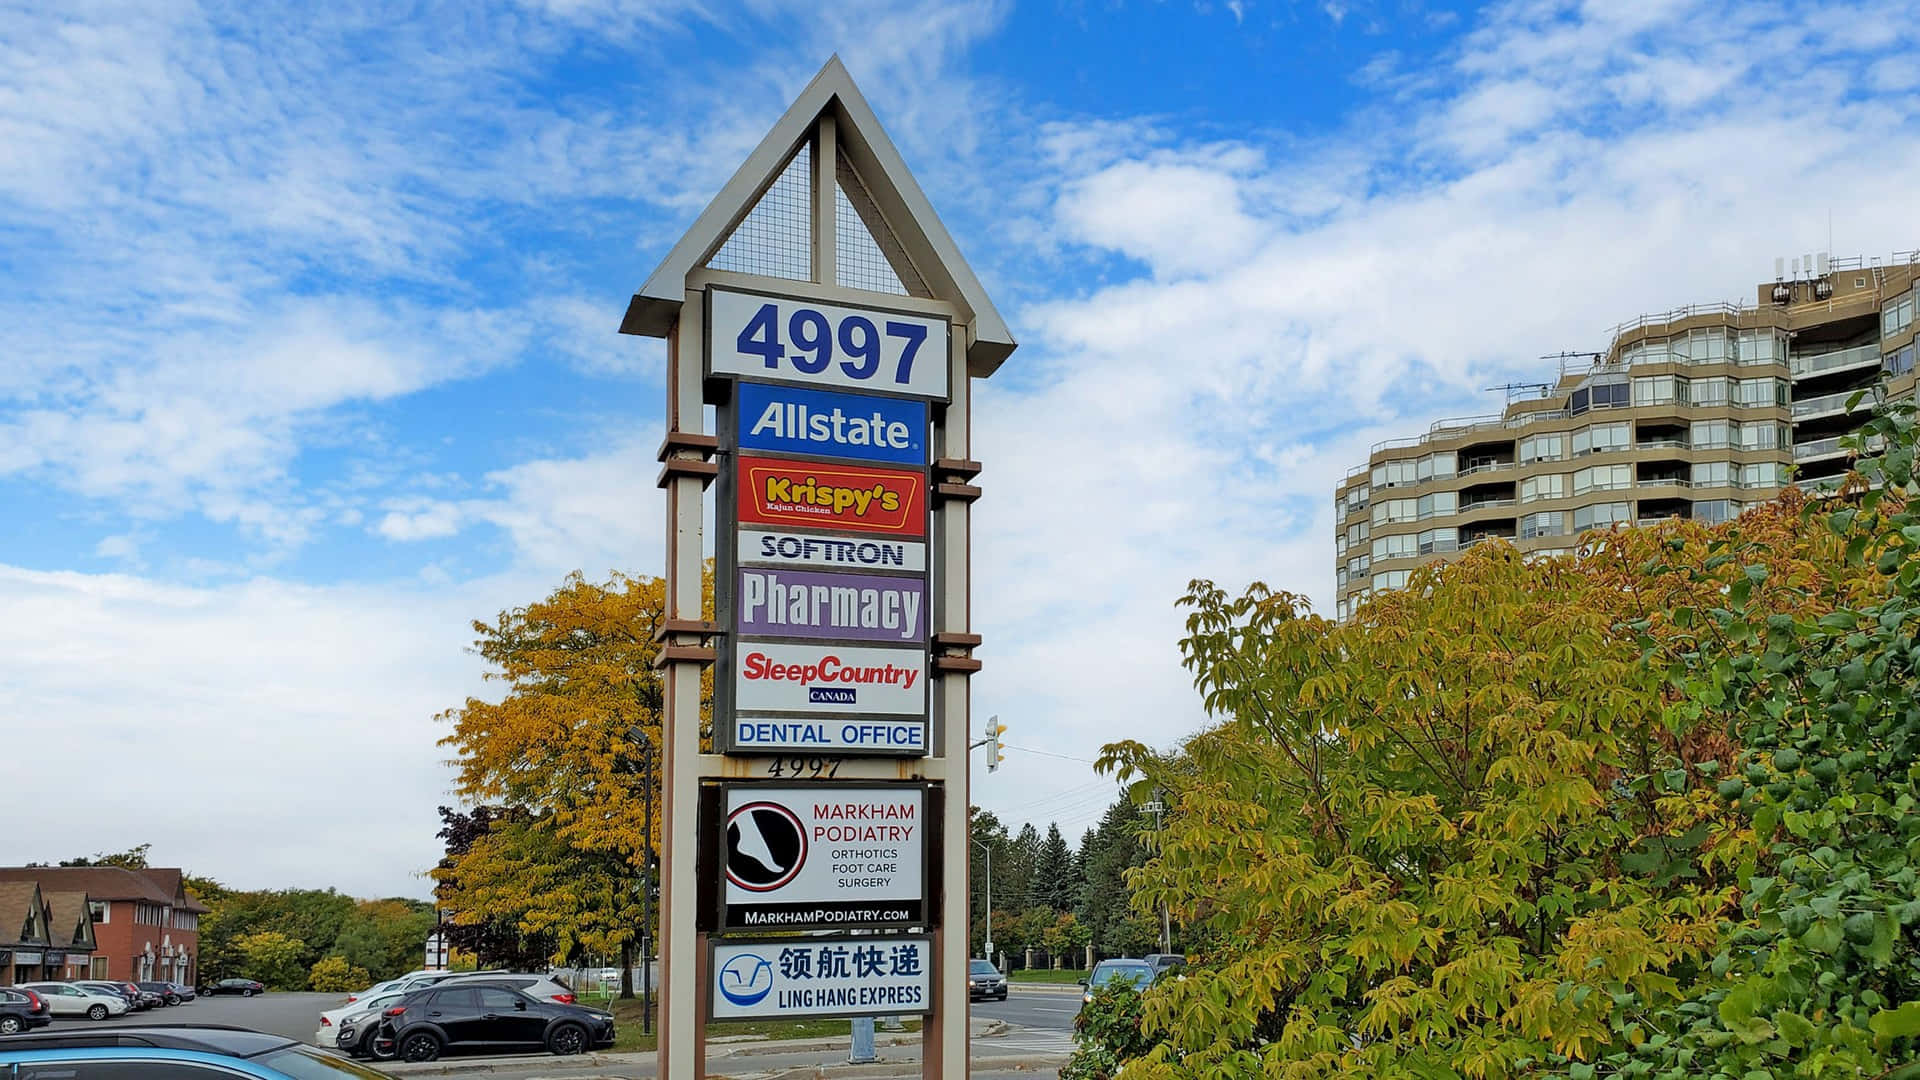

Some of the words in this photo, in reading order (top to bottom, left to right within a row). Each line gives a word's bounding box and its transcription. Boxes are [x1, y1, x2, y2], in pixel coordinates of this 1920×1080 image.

[737, 303, 928, 385] 4997
[750, 402, 910, 449] Allstate
[765, 476, 900, 517] Krispy's
[766, 503, 794, 512] Kajun
[795, 505, 831, 514] Chicken
[761, 535, 904, 565] SOFTRON
[743, 572, 922, 639] Pharmacy
[810, 691, 855, 703] CANADA
[739, 723, 831, 743] DENTAL
[841, 725, 922, 745] OFFICE
[768, 756, 843, 778] 4997
[814, 804, 915, 820] MARKHAM
[814, 826, 914, 842] PODIATRY
[831, 849, 898, 859] ORTHOTICS
[832, 864, 864, 874] FOOT
[867, 863, 897, 873] CARE
[838, 878, 891, 888] SURGERY
[778, 944, 923, 980] 领航快递
[778, 989, 813, 1009] LING
[816, 988, 857, 1007] HANG
[860, 986, 922, 1005] EXPRESS
